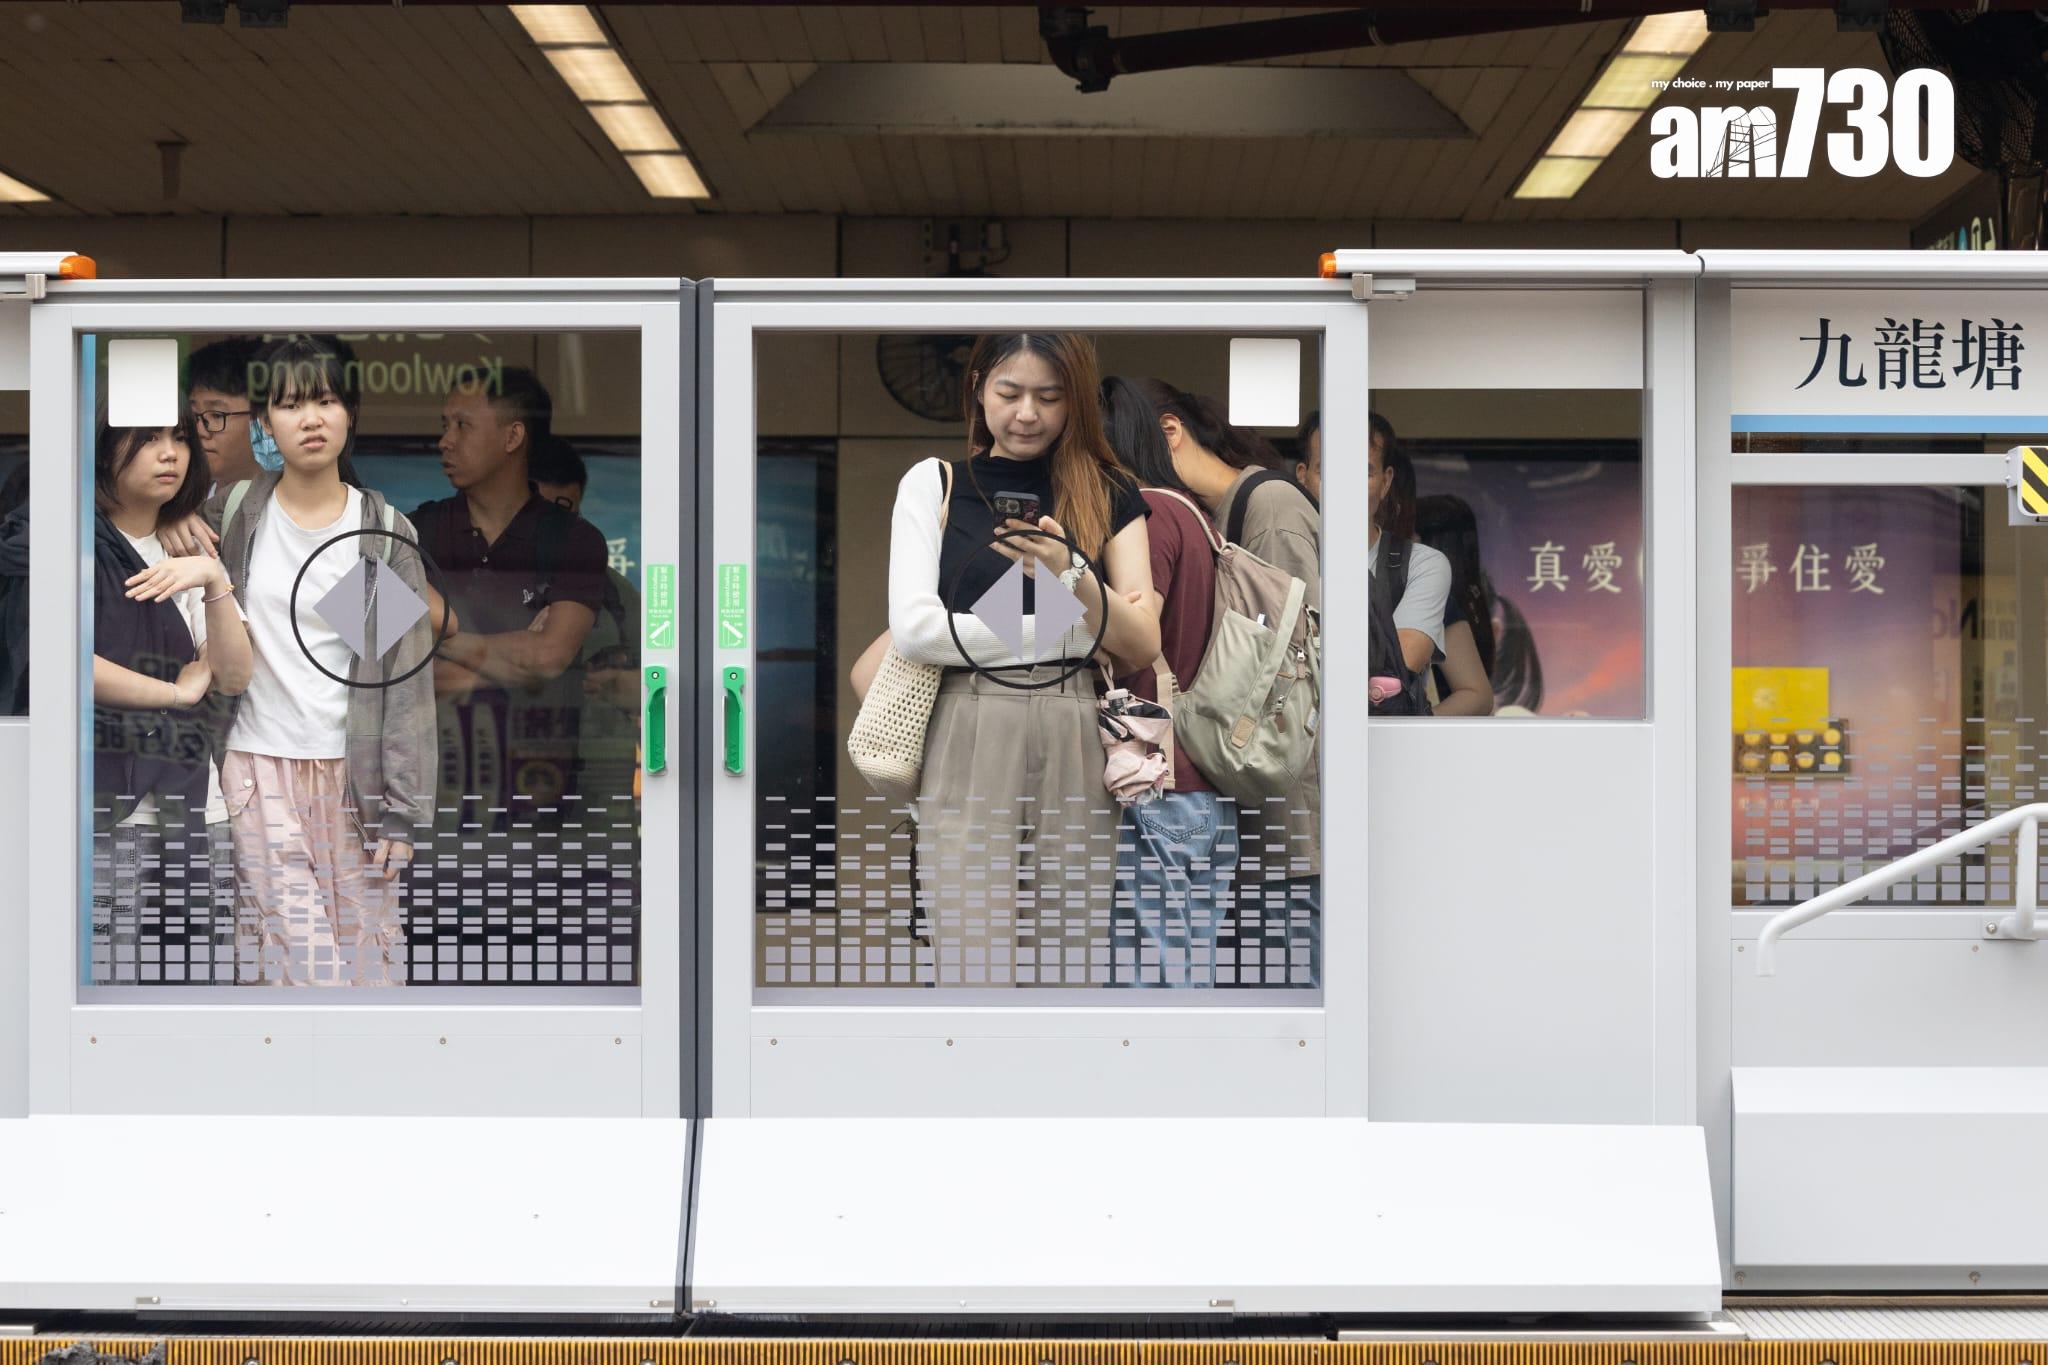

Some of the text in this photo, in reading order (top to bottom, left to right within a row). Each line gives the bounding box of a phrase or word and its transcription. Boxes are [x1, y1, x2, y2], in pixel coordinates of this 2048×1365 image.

[1794, 317, 2025, 391] 九龍塘
[1527, 540, 1623, 594] 真愛
